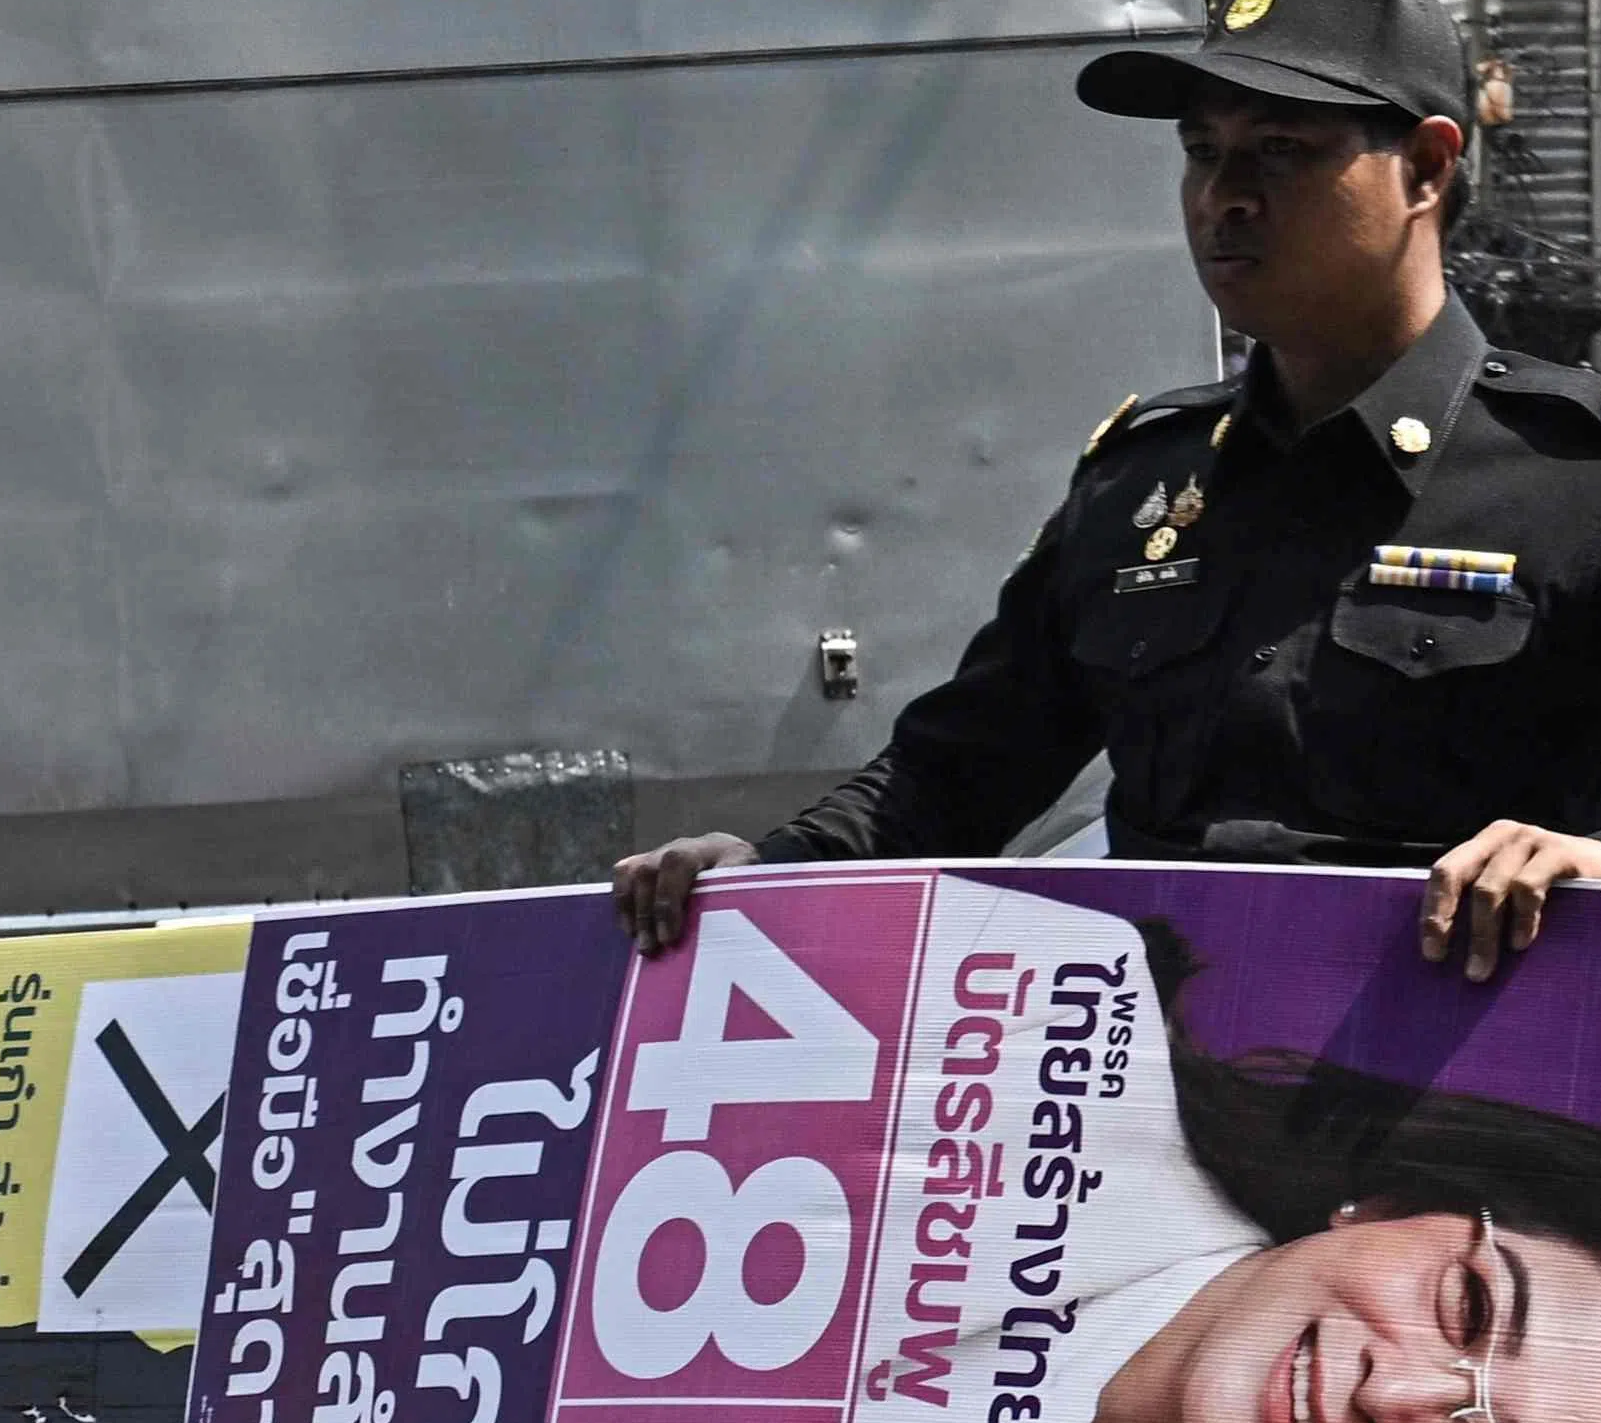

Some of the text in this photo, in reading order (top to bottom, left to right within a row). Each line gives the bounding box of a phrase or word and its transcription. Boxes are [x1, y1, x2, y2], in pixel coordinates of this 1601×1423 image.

[592, 909, 880, 1380] 48
[866, 952, 1036, 1410] บัตรสีชมพู
[1100, 991, 1139, 1098] พรรค
